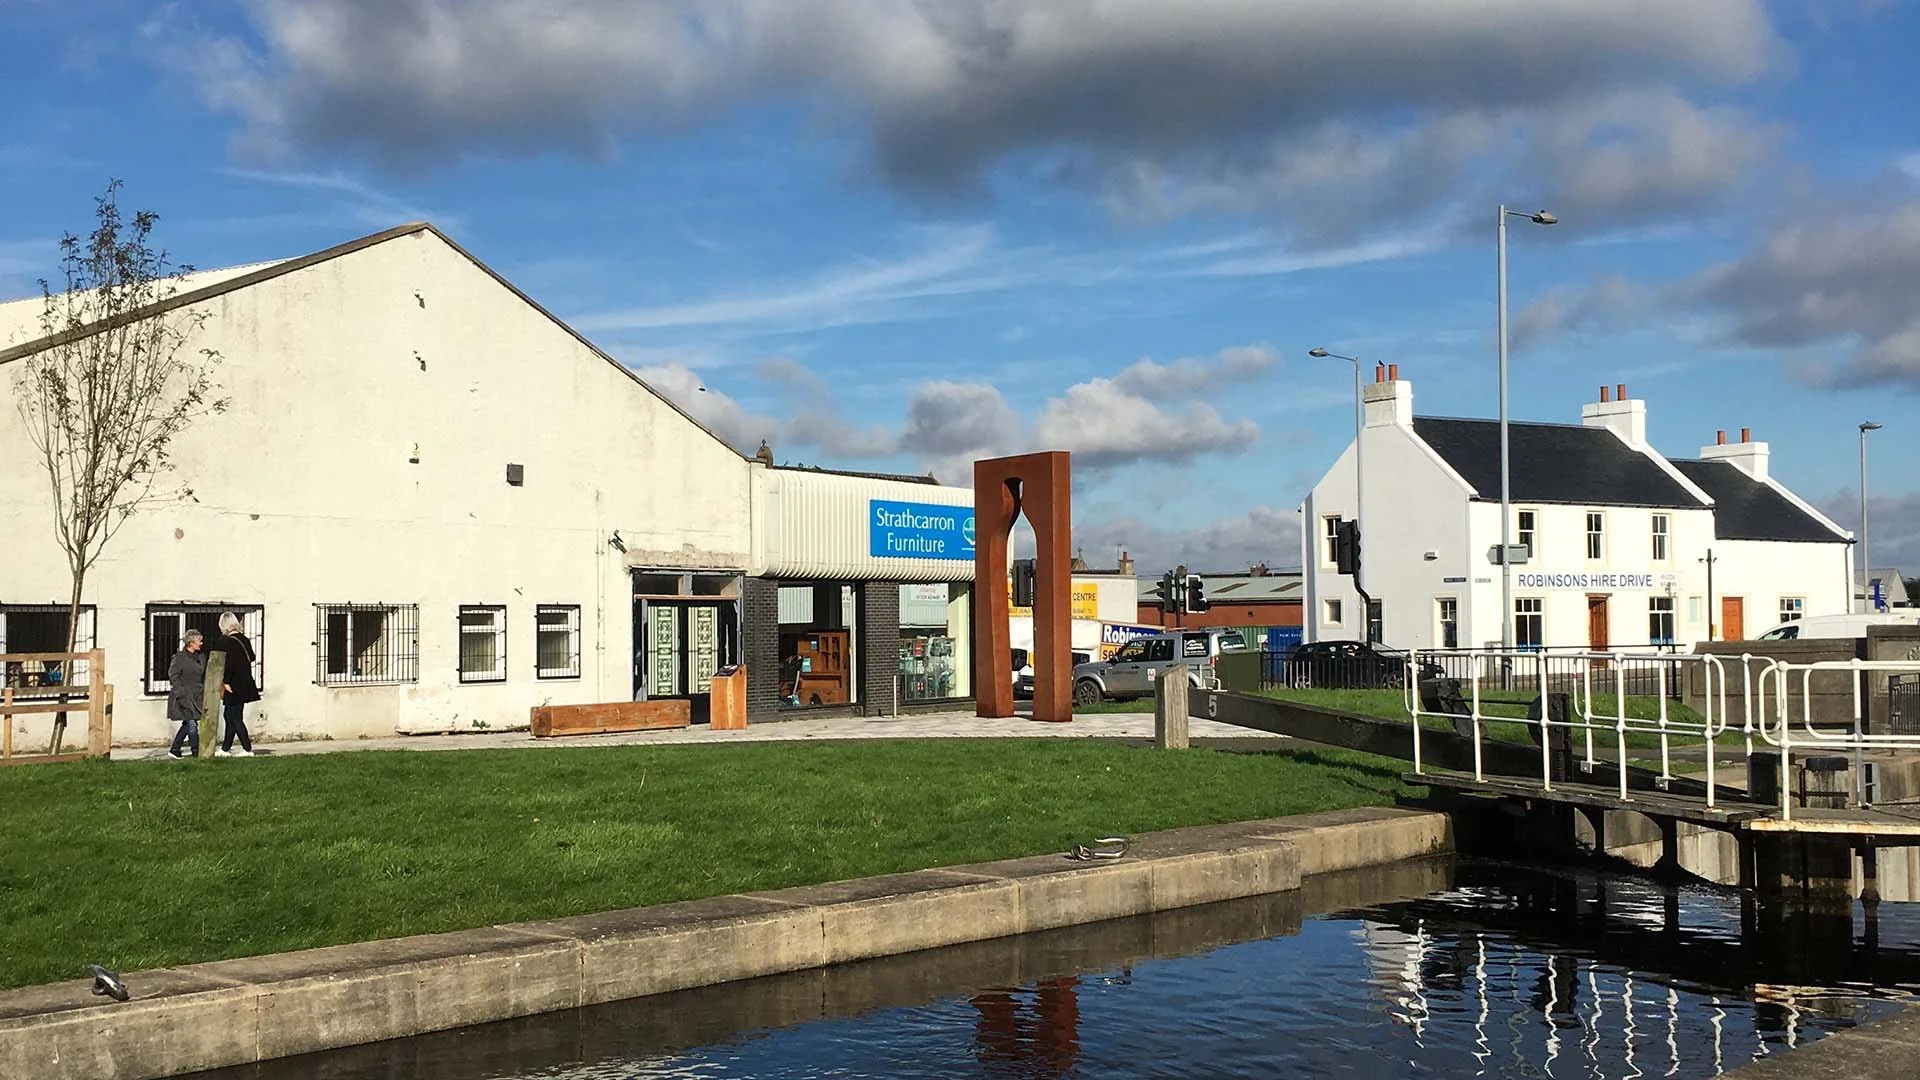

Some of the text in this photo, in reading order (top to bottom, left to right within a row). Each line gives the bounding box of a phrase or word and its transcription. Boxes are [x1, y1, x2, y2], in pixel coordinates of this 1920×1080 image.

[876, 507, 955, 531] Strathcarron
[887, 532, 945, 553] Furniture
[1518, 574, 1588, 587] ROBINSONS
[1590, 574, 1617, 587] HIRE
[1619, 574, 1652, 587] DRIVE
[1072, 592, 1097, 602] CENTRE
[1208, 694, 1217, 718] 5
